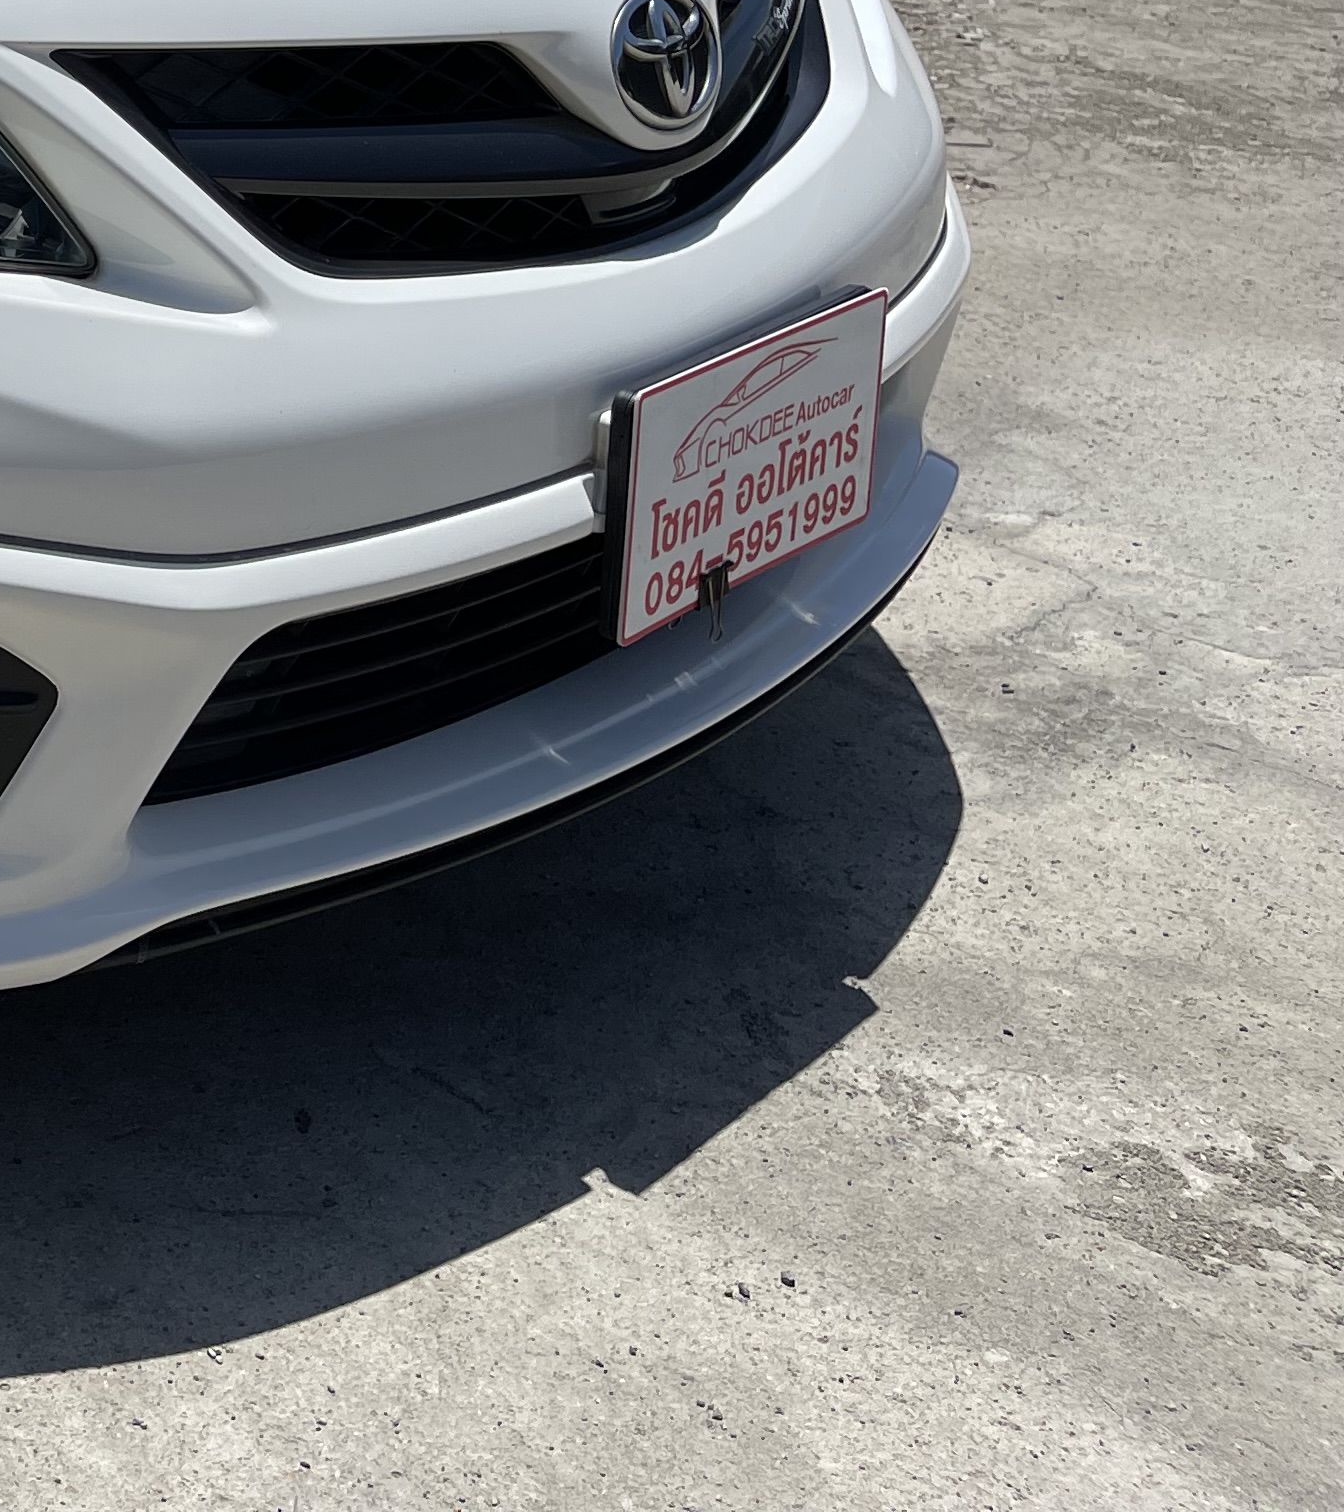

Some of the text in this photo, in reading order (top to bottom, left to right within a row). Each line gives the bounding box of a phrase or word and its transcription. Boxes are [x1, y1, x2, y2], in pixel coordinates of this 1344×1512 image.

[650, 404, 863, 561] โชคดี ออโต้คาร์
[704, 383, 856, 469] CHOKDEE Autocar
[644, 474, 857, 617] 084-5951999
